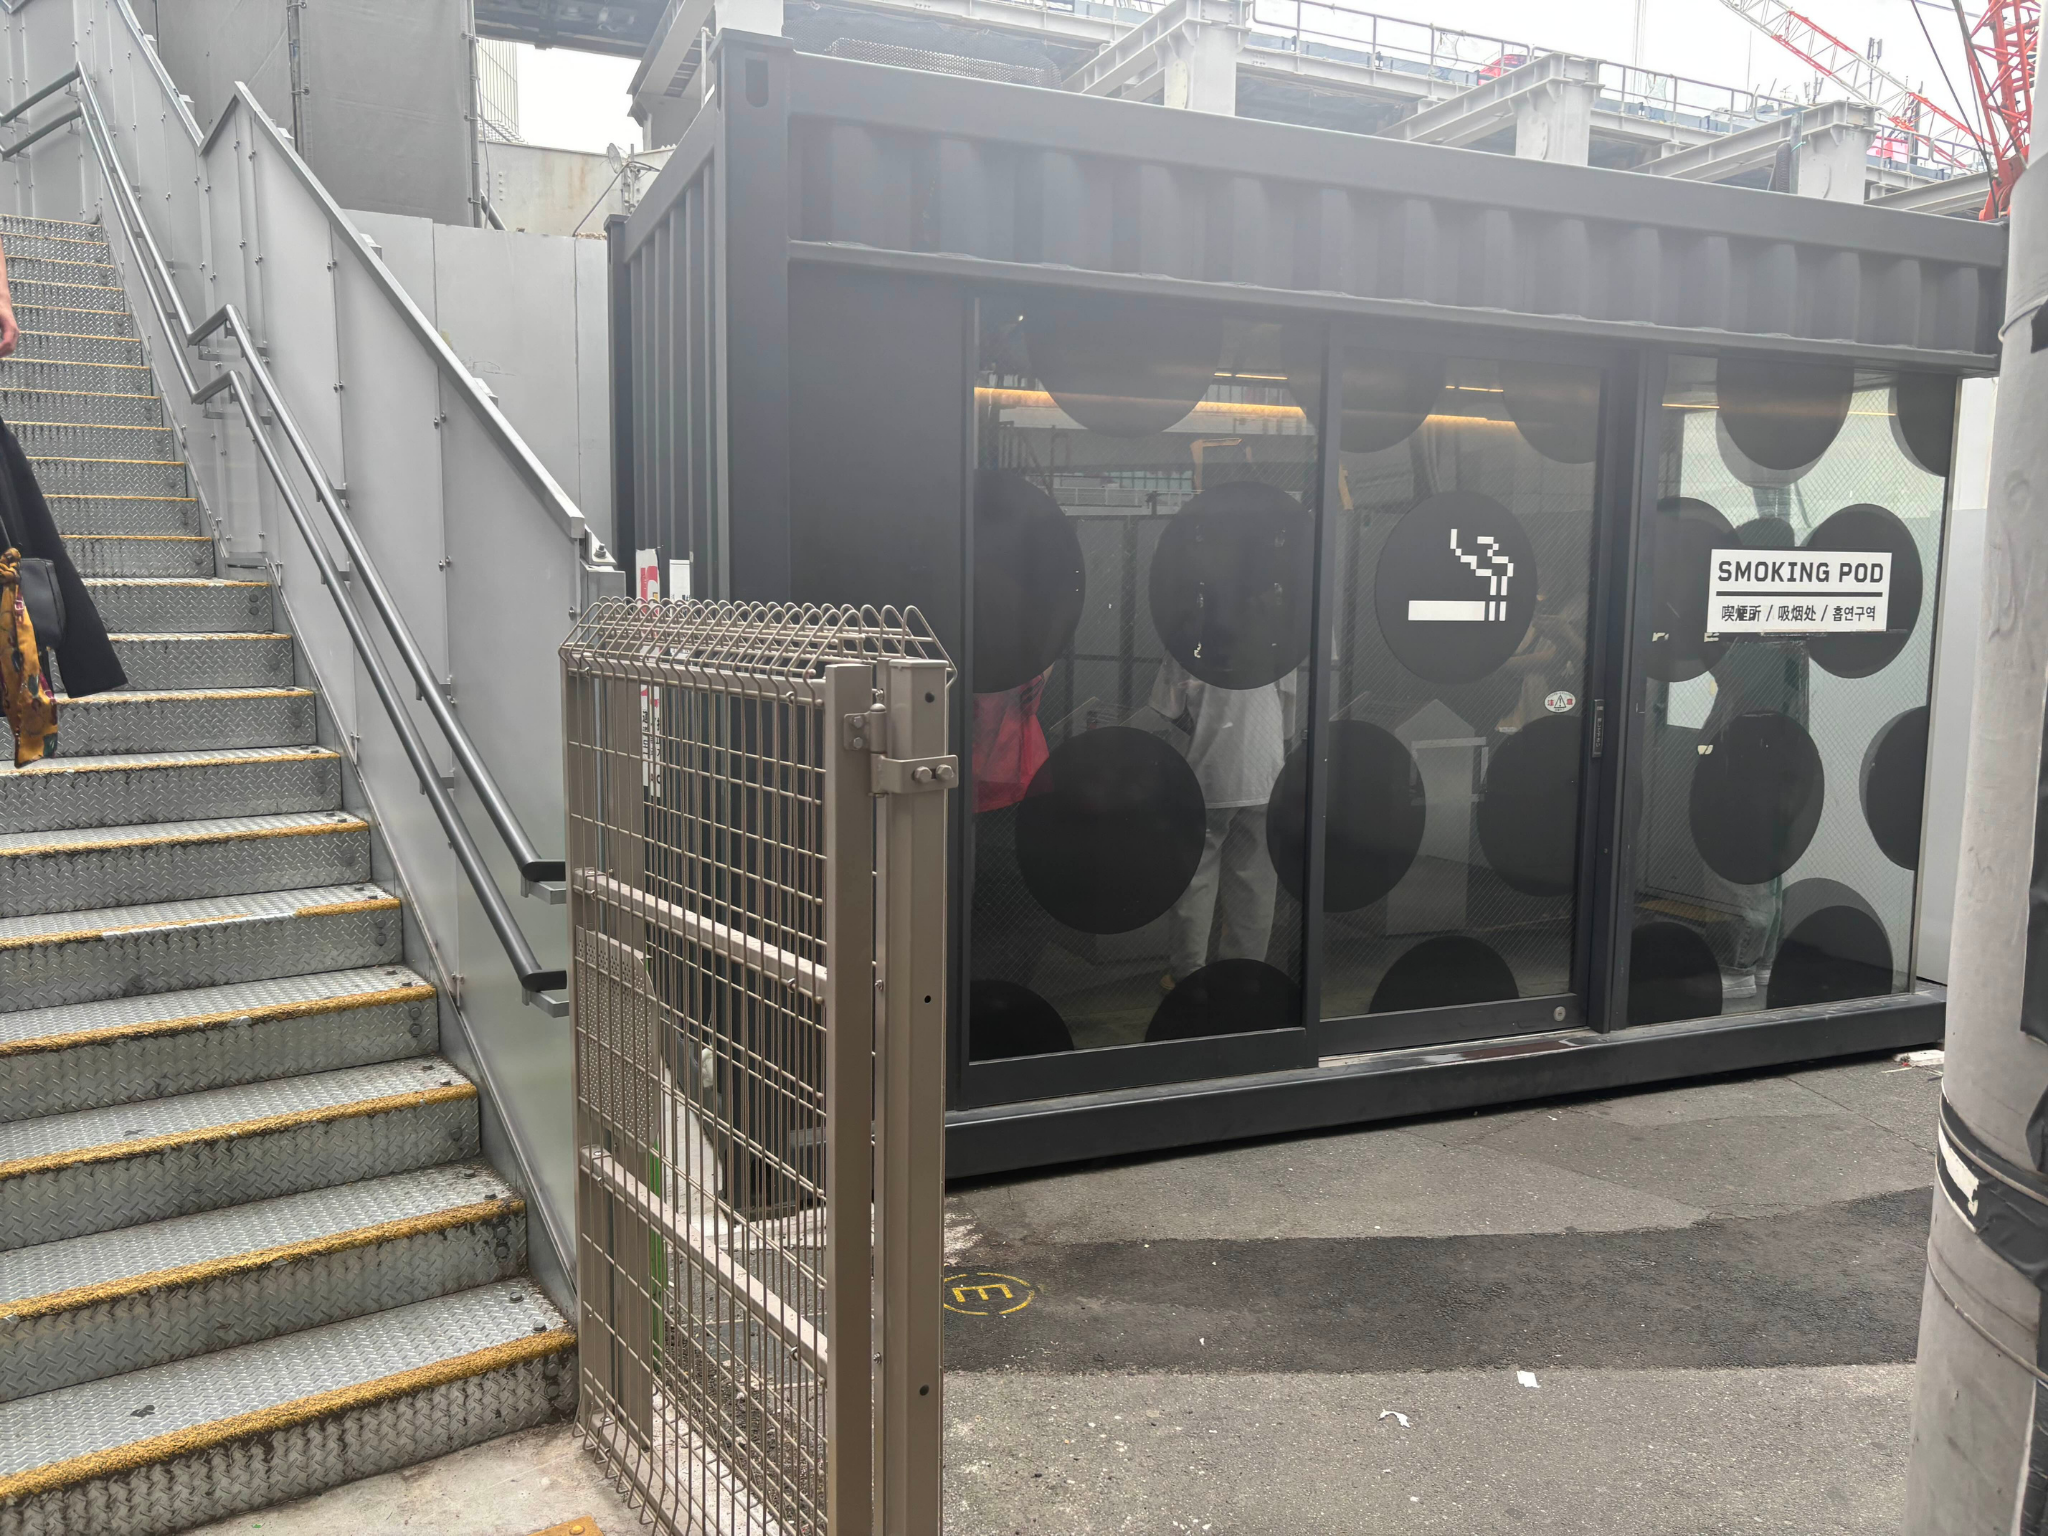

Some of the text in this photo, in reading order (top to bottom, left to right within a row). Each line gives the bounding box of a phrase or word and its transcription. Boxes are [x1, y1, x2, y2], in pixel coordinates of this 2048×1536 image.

[1718, 561, 1883, 582] SMOKING POD
[1777, 604, 1816, 622] 吸烟处
[1832, 605, 1876, 621] 흡연구역
